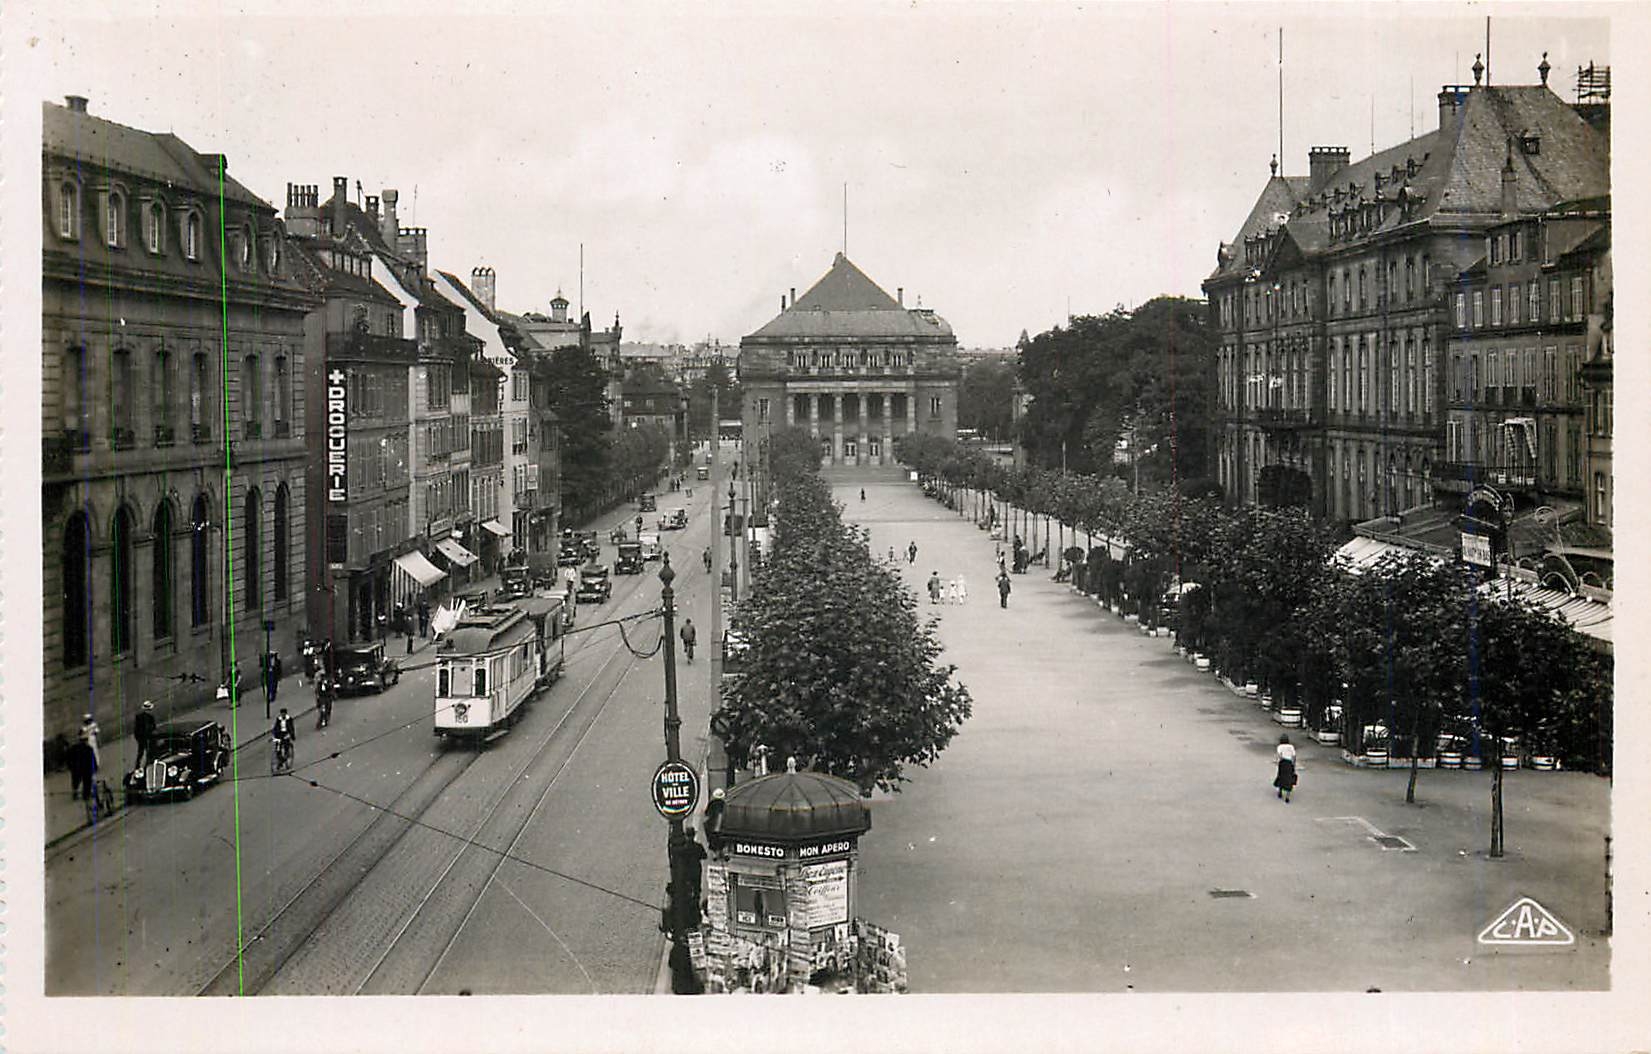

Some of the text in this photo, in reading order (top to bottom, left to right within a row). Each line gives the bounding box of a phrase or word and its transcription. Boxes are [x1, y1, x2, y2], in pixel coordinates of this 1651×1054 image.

[329, 386, 346, 502] DROGUERIE
[662, 786, 690, 799] VILLE
[736, 843, 785, 858] BONESTO
[800, 841, 850, 857] MON APERO
